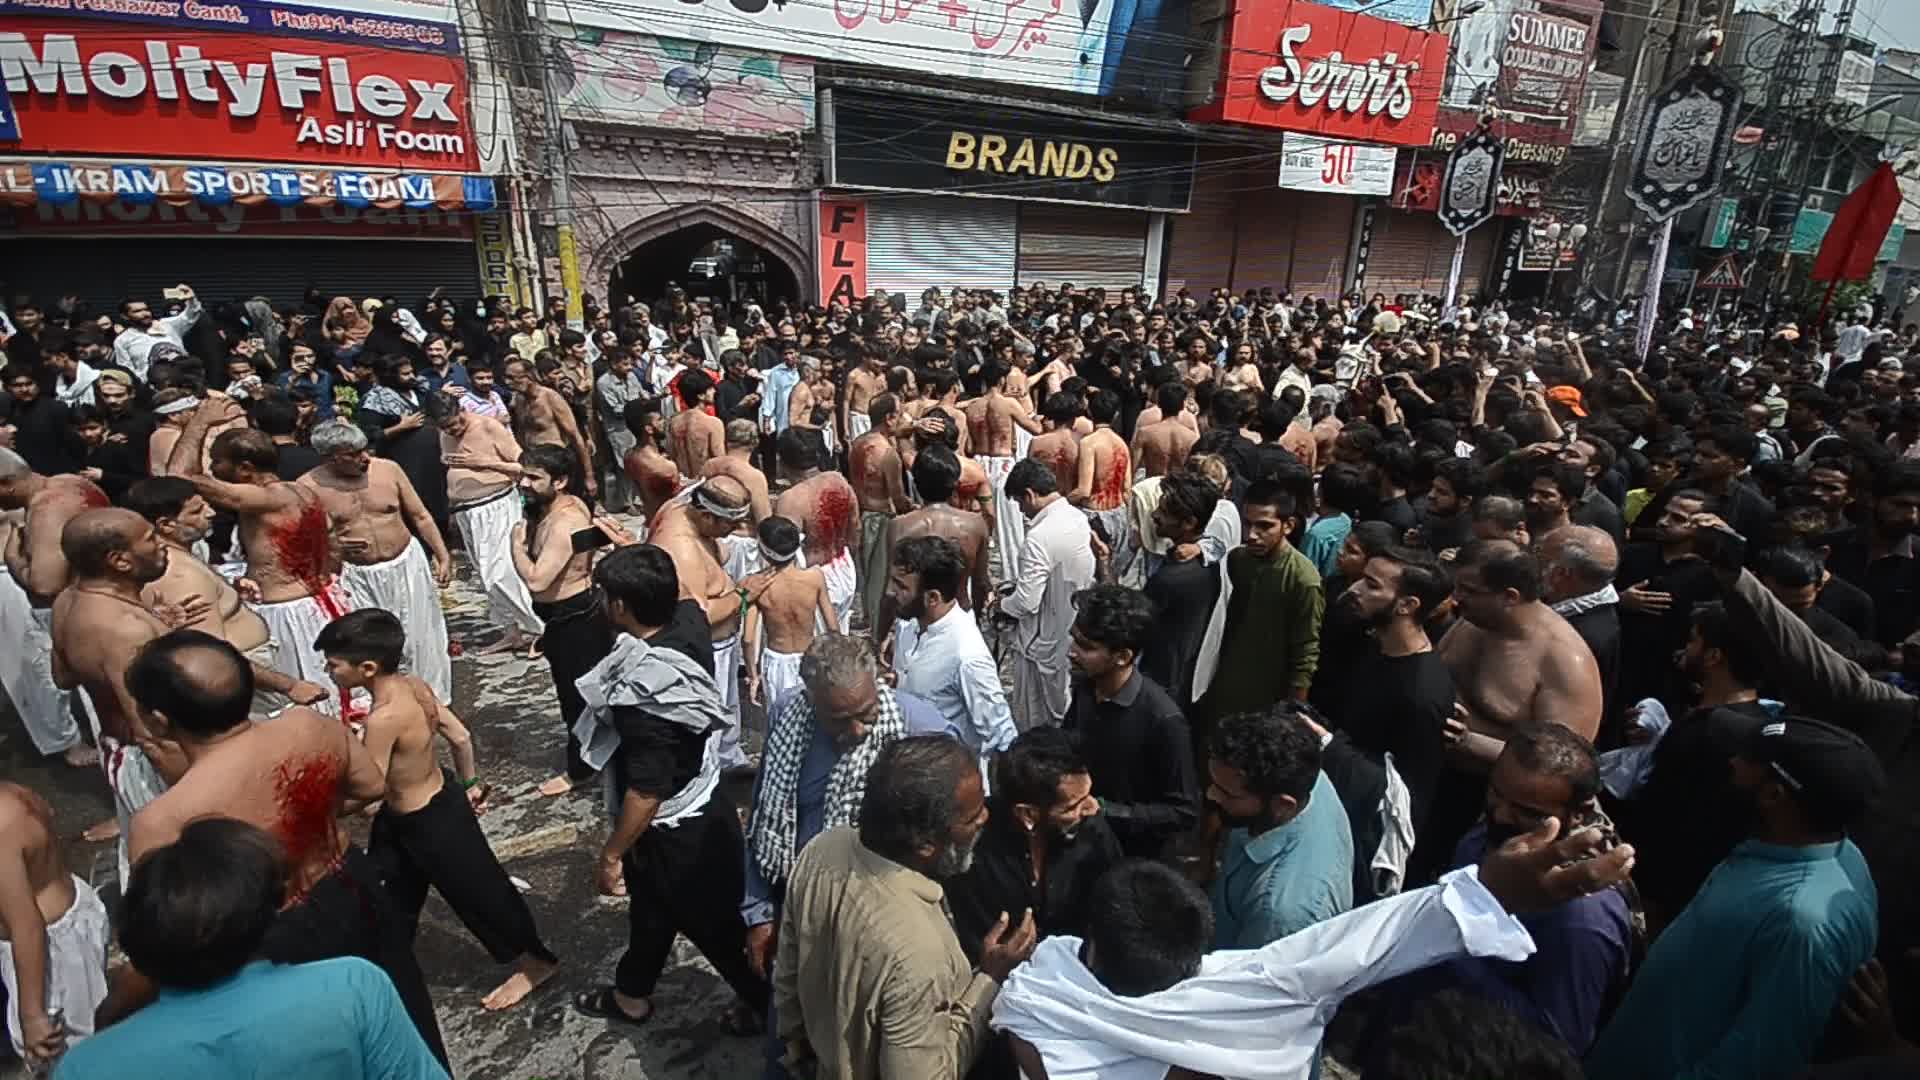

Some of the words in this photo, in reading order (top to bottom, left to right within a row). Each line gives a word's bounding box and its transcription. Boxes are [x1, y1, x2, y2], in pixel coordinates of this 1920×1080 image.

[184, 2, 249, 23] Cantt.
[1508, 14, 1585, 55] SUMMER
[0, 32, 460, 123] MoltyFlex
[376, 123, 465, 154] Foam
[1505, 138, 1566, 166] Dressing
[946, 131, 1119, 182] BRANDS
[182, 170, 320, 197] SPORTS
[336, 174, 437, 201] FOAM
